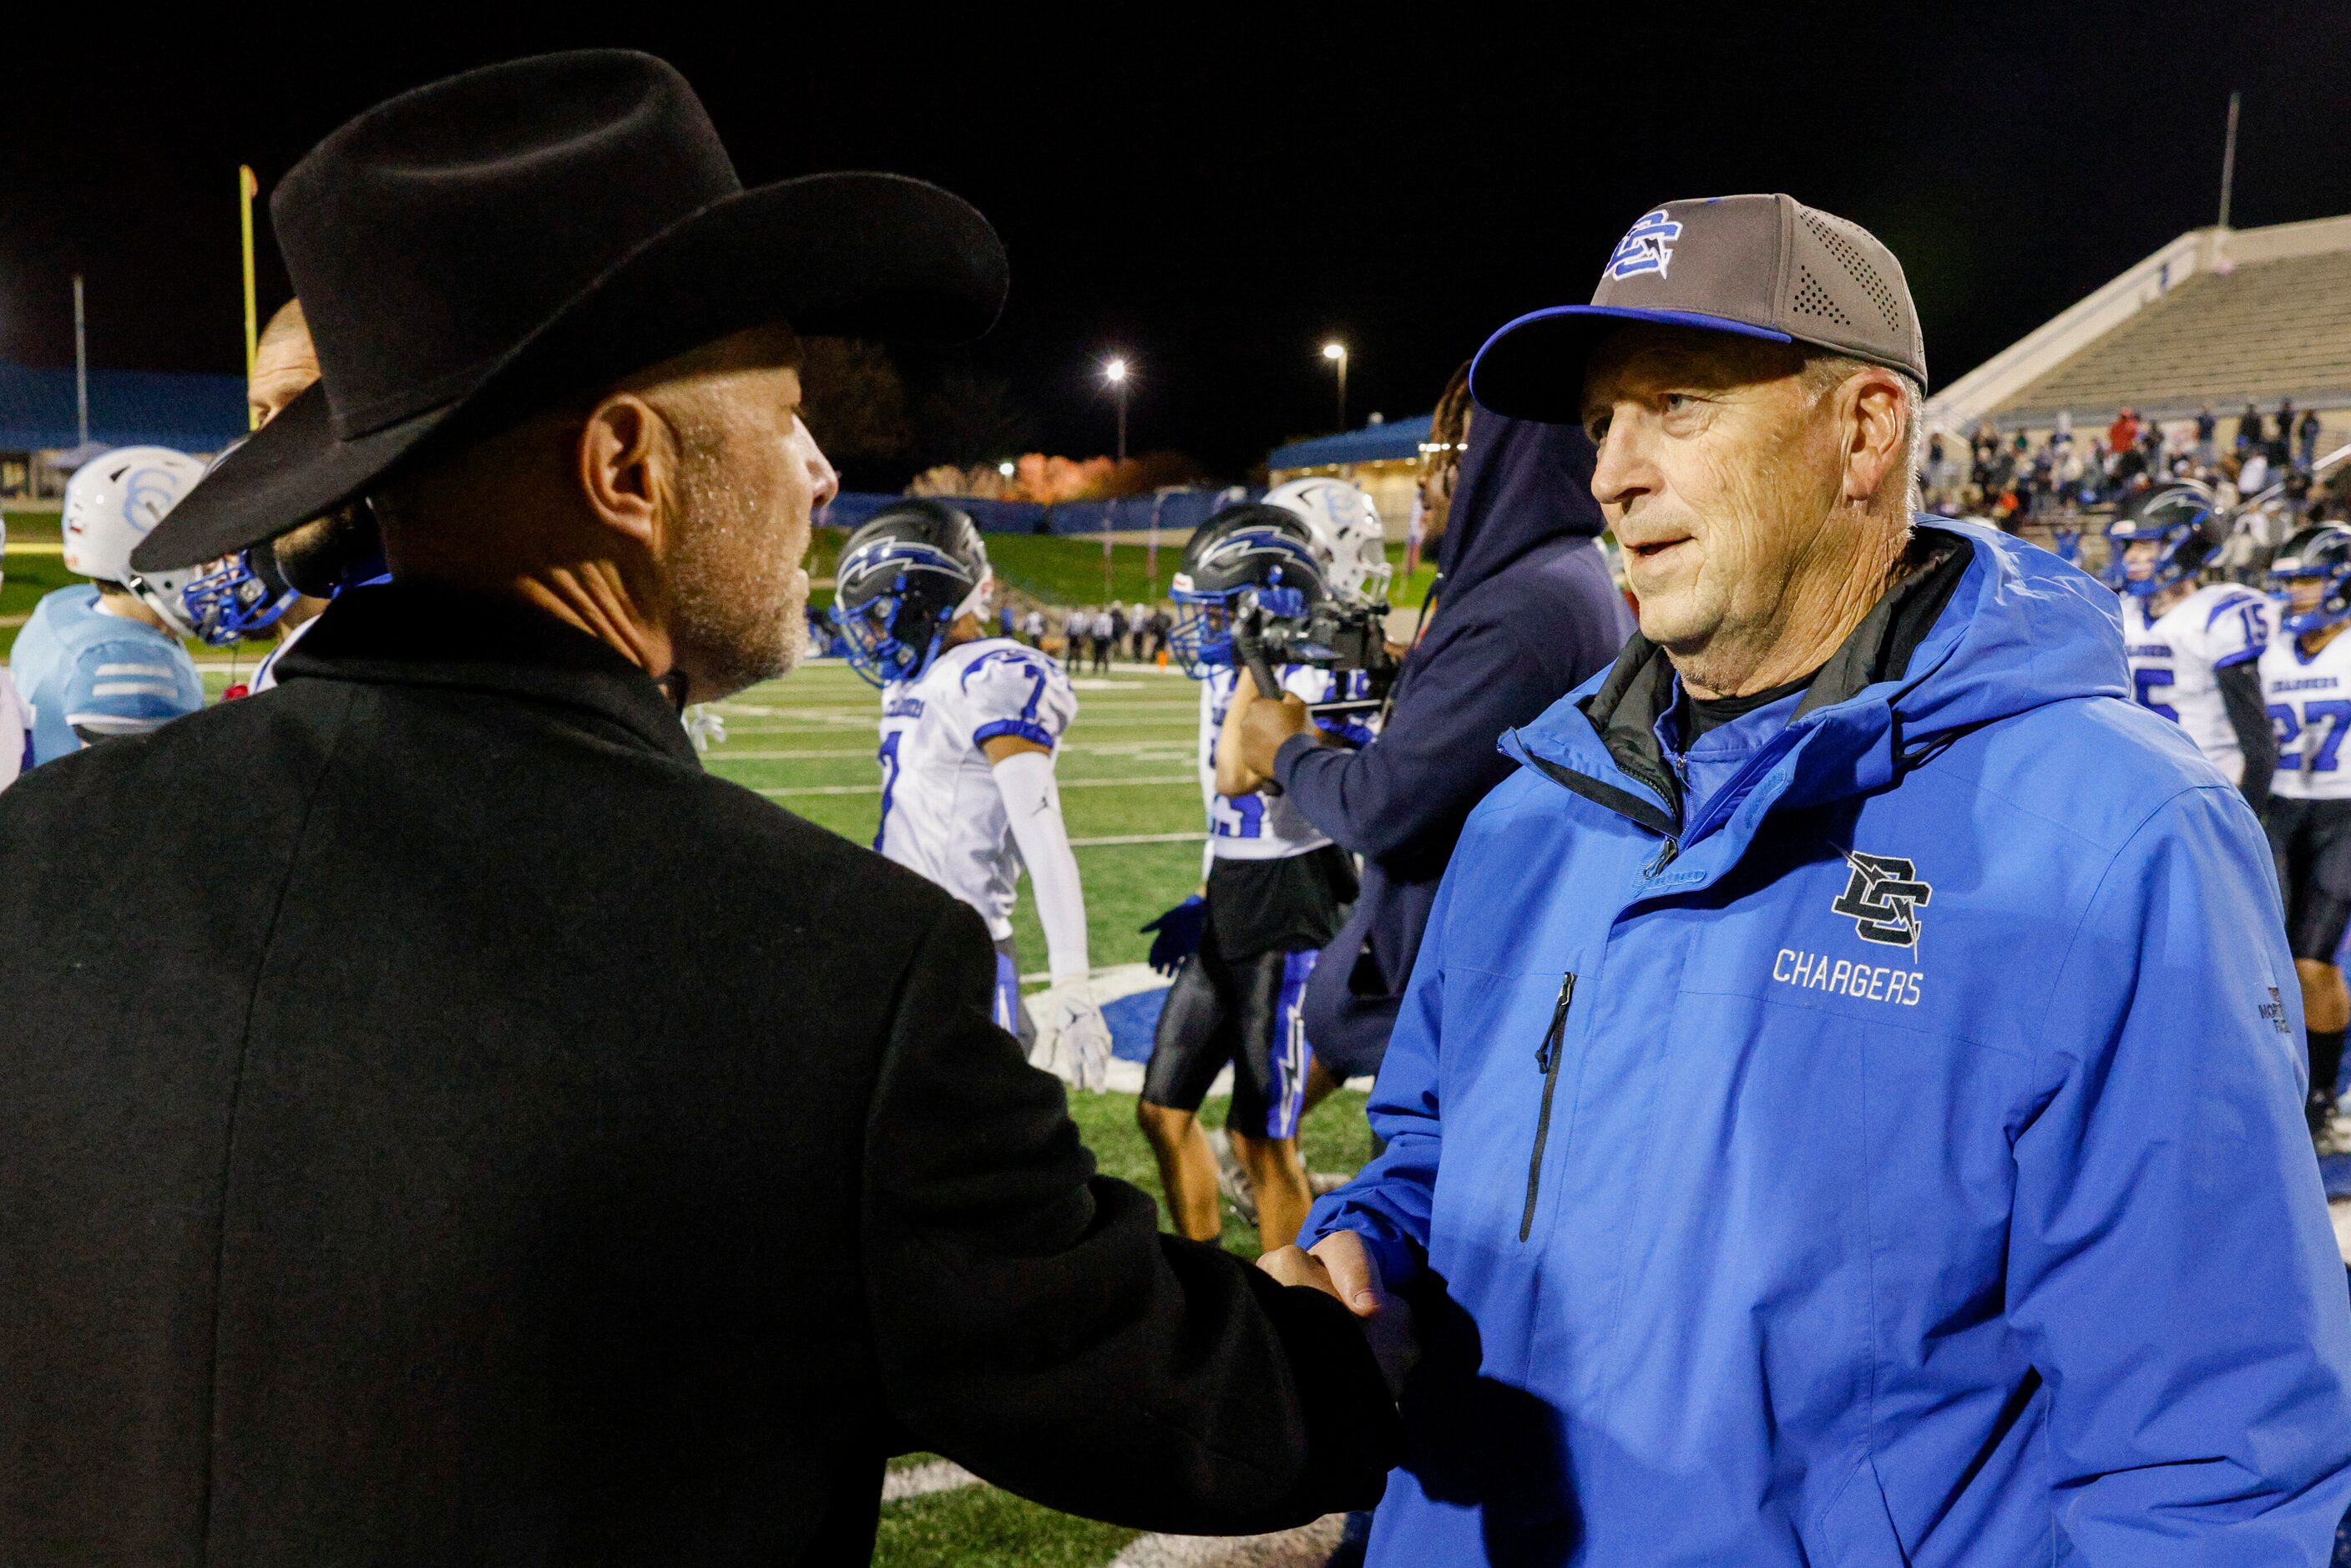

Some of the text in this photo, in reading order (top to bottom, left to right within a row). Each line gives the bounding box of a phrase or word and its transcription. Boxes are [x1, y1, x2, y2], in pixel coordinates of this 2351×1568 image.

[2239, 603, 2268, 646] 15
[1021, 664, 1046, 719] 7
[2266, 700, 2351, 772] 27
[1772, 948, 1924, 1006] CHARGERS
